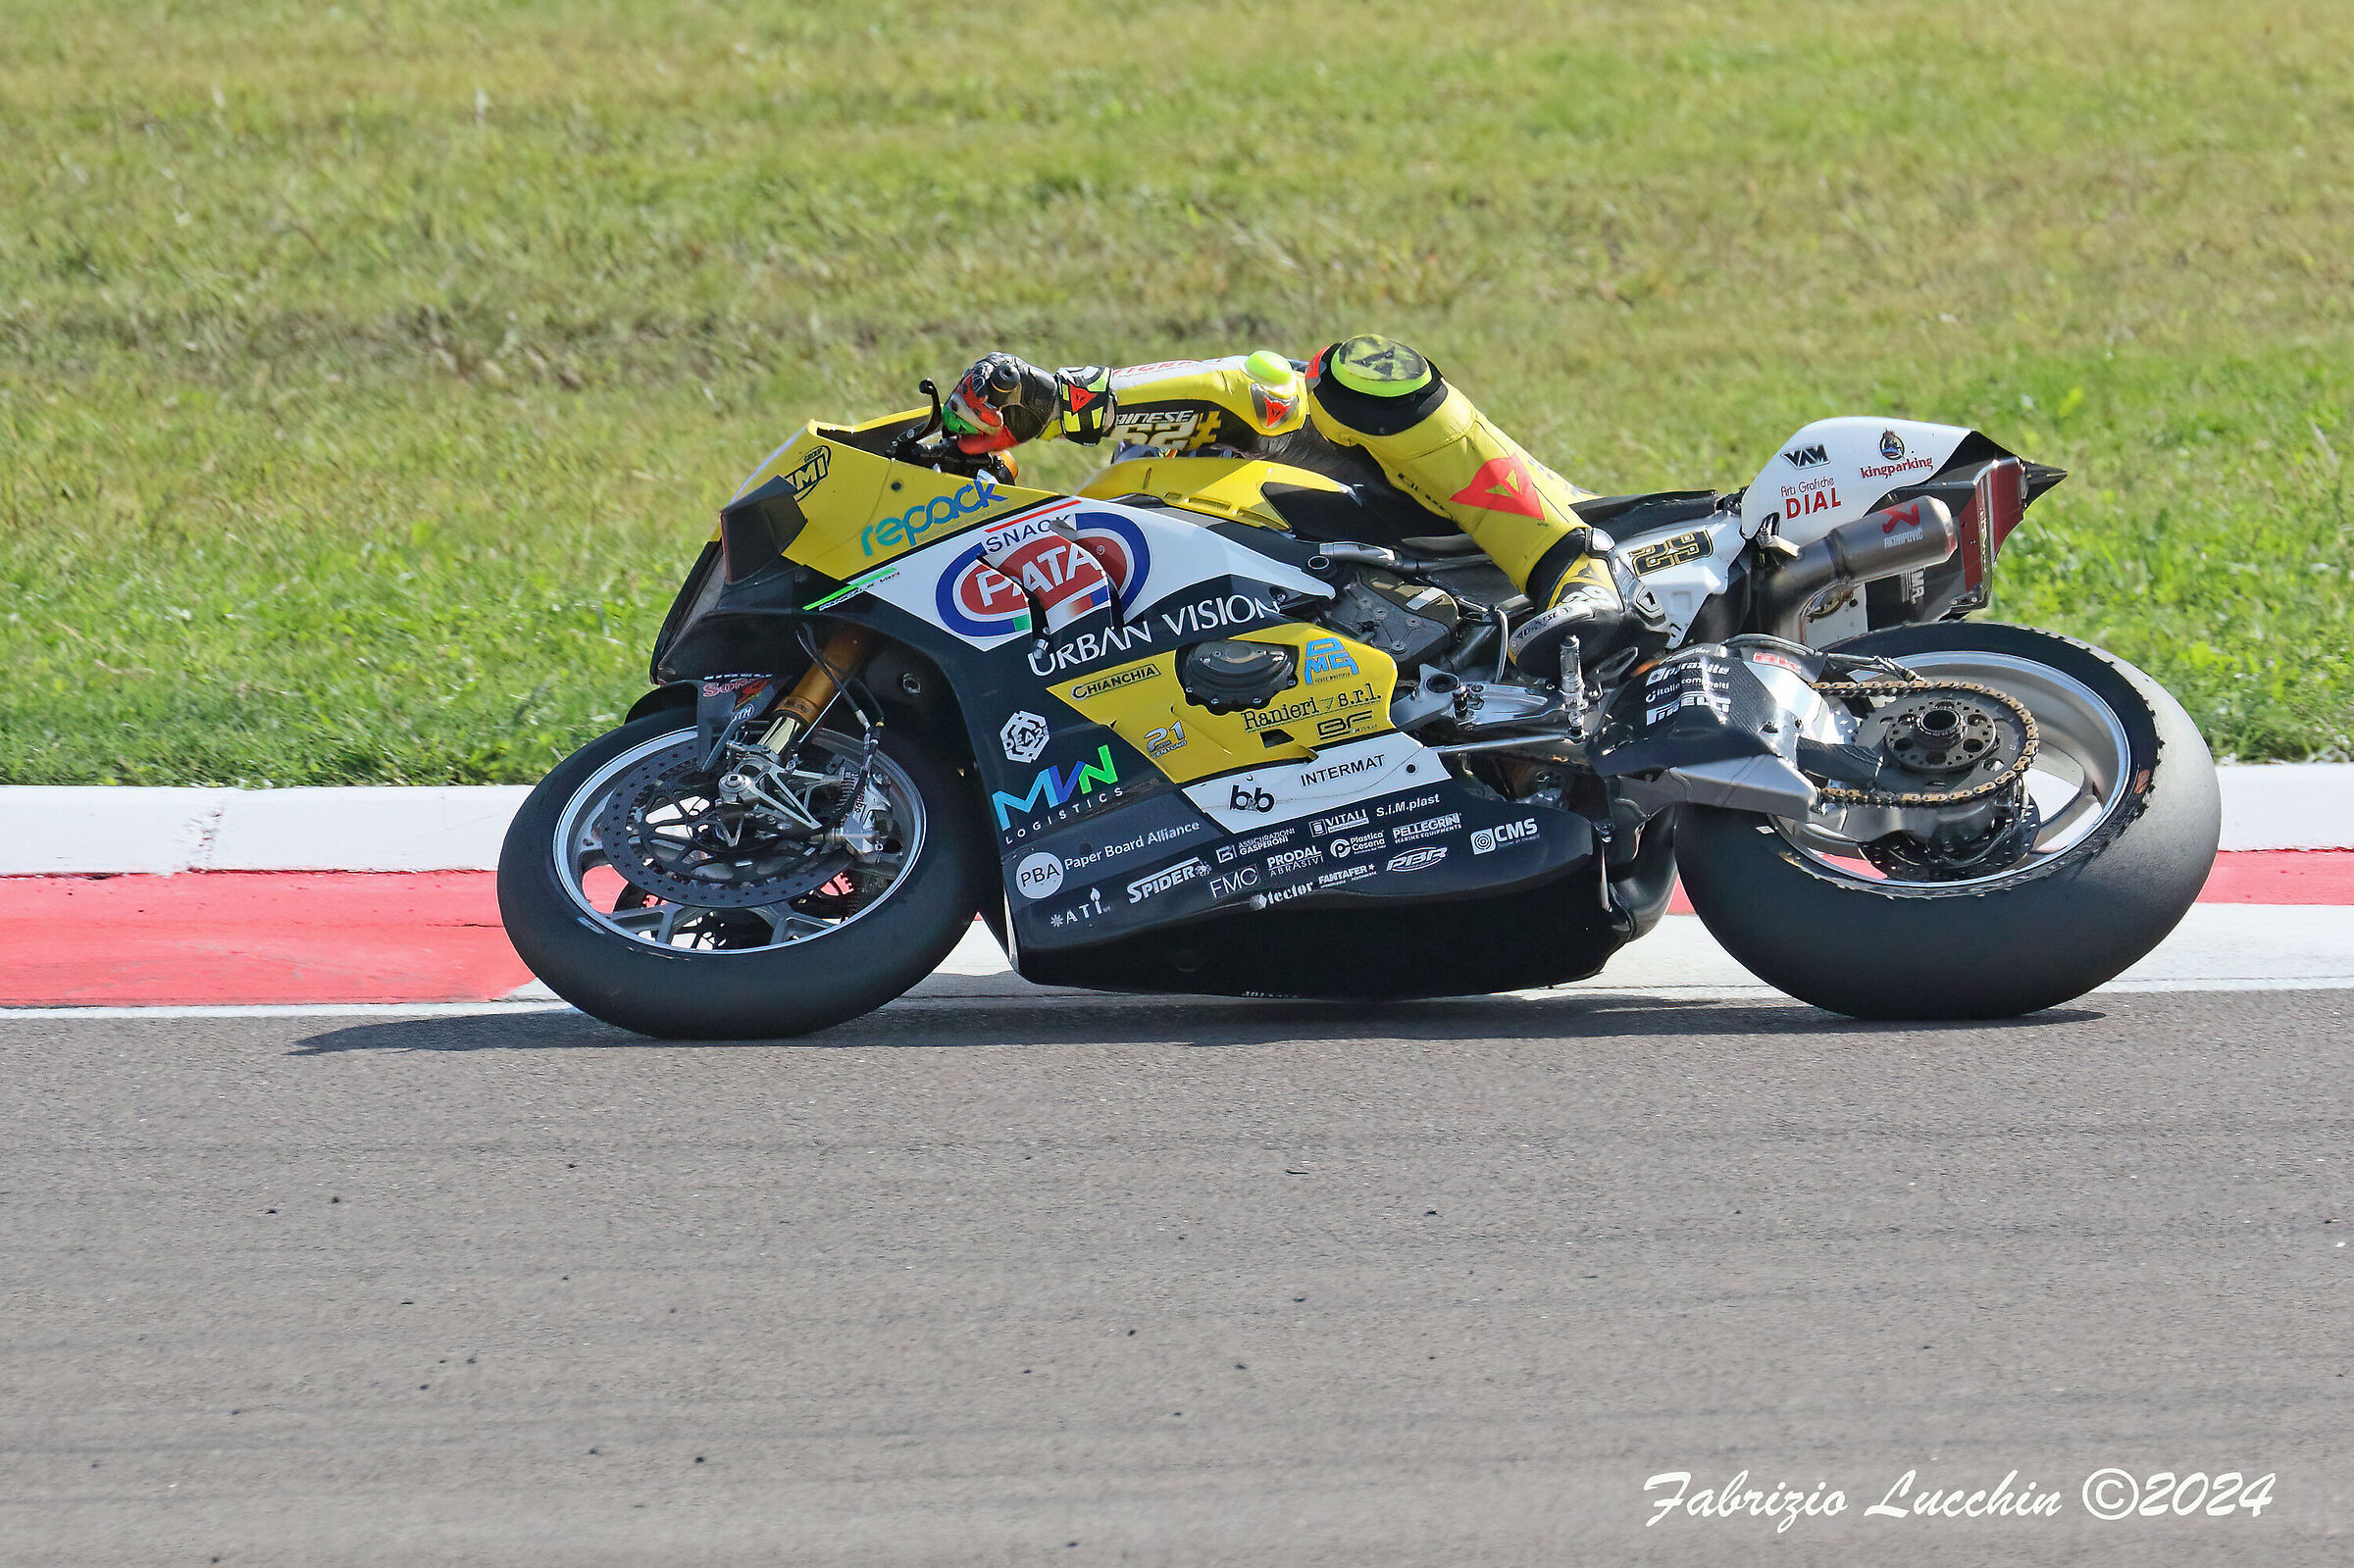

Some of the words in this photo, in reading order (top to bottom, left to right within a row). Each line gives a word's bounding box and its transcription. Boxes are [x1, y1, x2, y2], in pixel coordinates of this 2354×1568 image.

[1861, 457, 1933, 479] kingparking
[1786, 487, 1842, 520] DIAL
[861, 480, 1009, 557] repack
[976, 542, 1102, 608] PATA
[1028, 621, 1152, 677] URBAN
[1161, 594, 1281, 637] VISION
[1071, 667, 1156, 699] CHIANCHIA
[1241, 697, 1320, 732] Ranieri
[1338, 683, 1382, 707] s.r.l.
[1301, 754, 1385, 786] INTERMAT
[1005, 787, 1123, 844] LOGISTICS
[1325, 809, 1366, 826] VITALI
[1393, 813, 1460, 838] PELLEGRIN
[1238, 828, 1296, 849] ASSICURAZIONI
[1494, 818, 1538, 842] CMS
[1064, 849, 1102, 871] Paper
[1104, 835, 1144, 858] Board
[1148, 821, 1201, 845] Alliance
[1239, 835, 1289, 855] GASPERONI
[1266, 845, 1322, 868] PRODAL
[1020, 863, 1061, 887] PBA
[1270, 856, 1324, 878] ABRASIVI
[1318, 865, 1368, 885] FANTAFER
[1127, 863, 1197, 904] SPIDER
